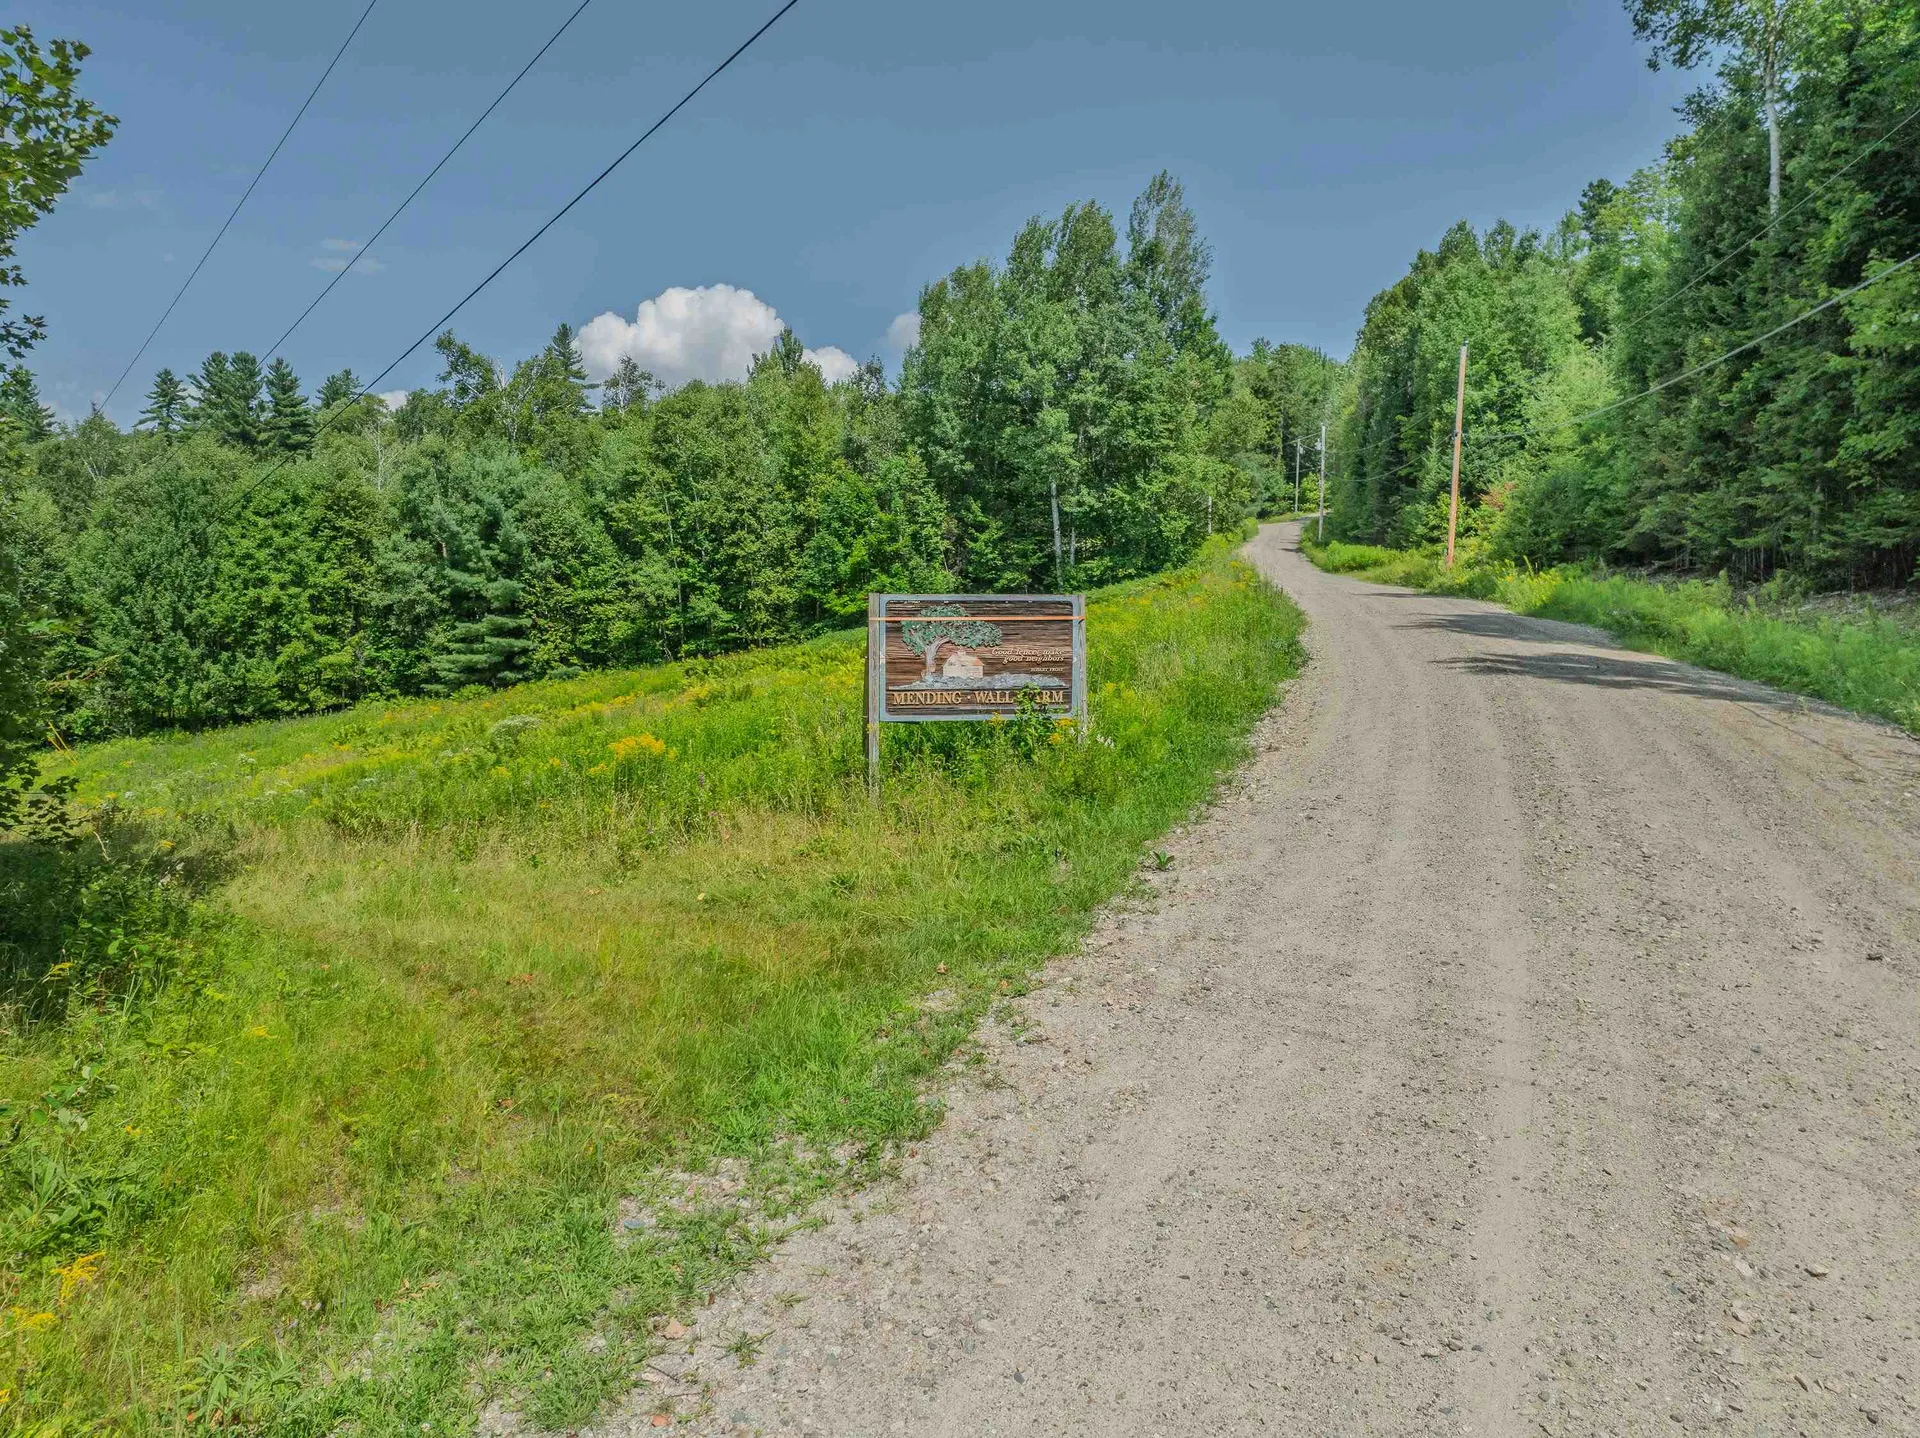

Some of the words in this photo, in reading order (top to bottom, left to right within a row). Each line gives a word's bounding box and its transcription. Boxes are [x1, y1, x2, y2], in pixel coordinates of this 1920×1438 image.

[1002, 655, 1025, 664] good
[892, 691, 962, 705] MENDING
[973, 690, 1014, 704] WALL
